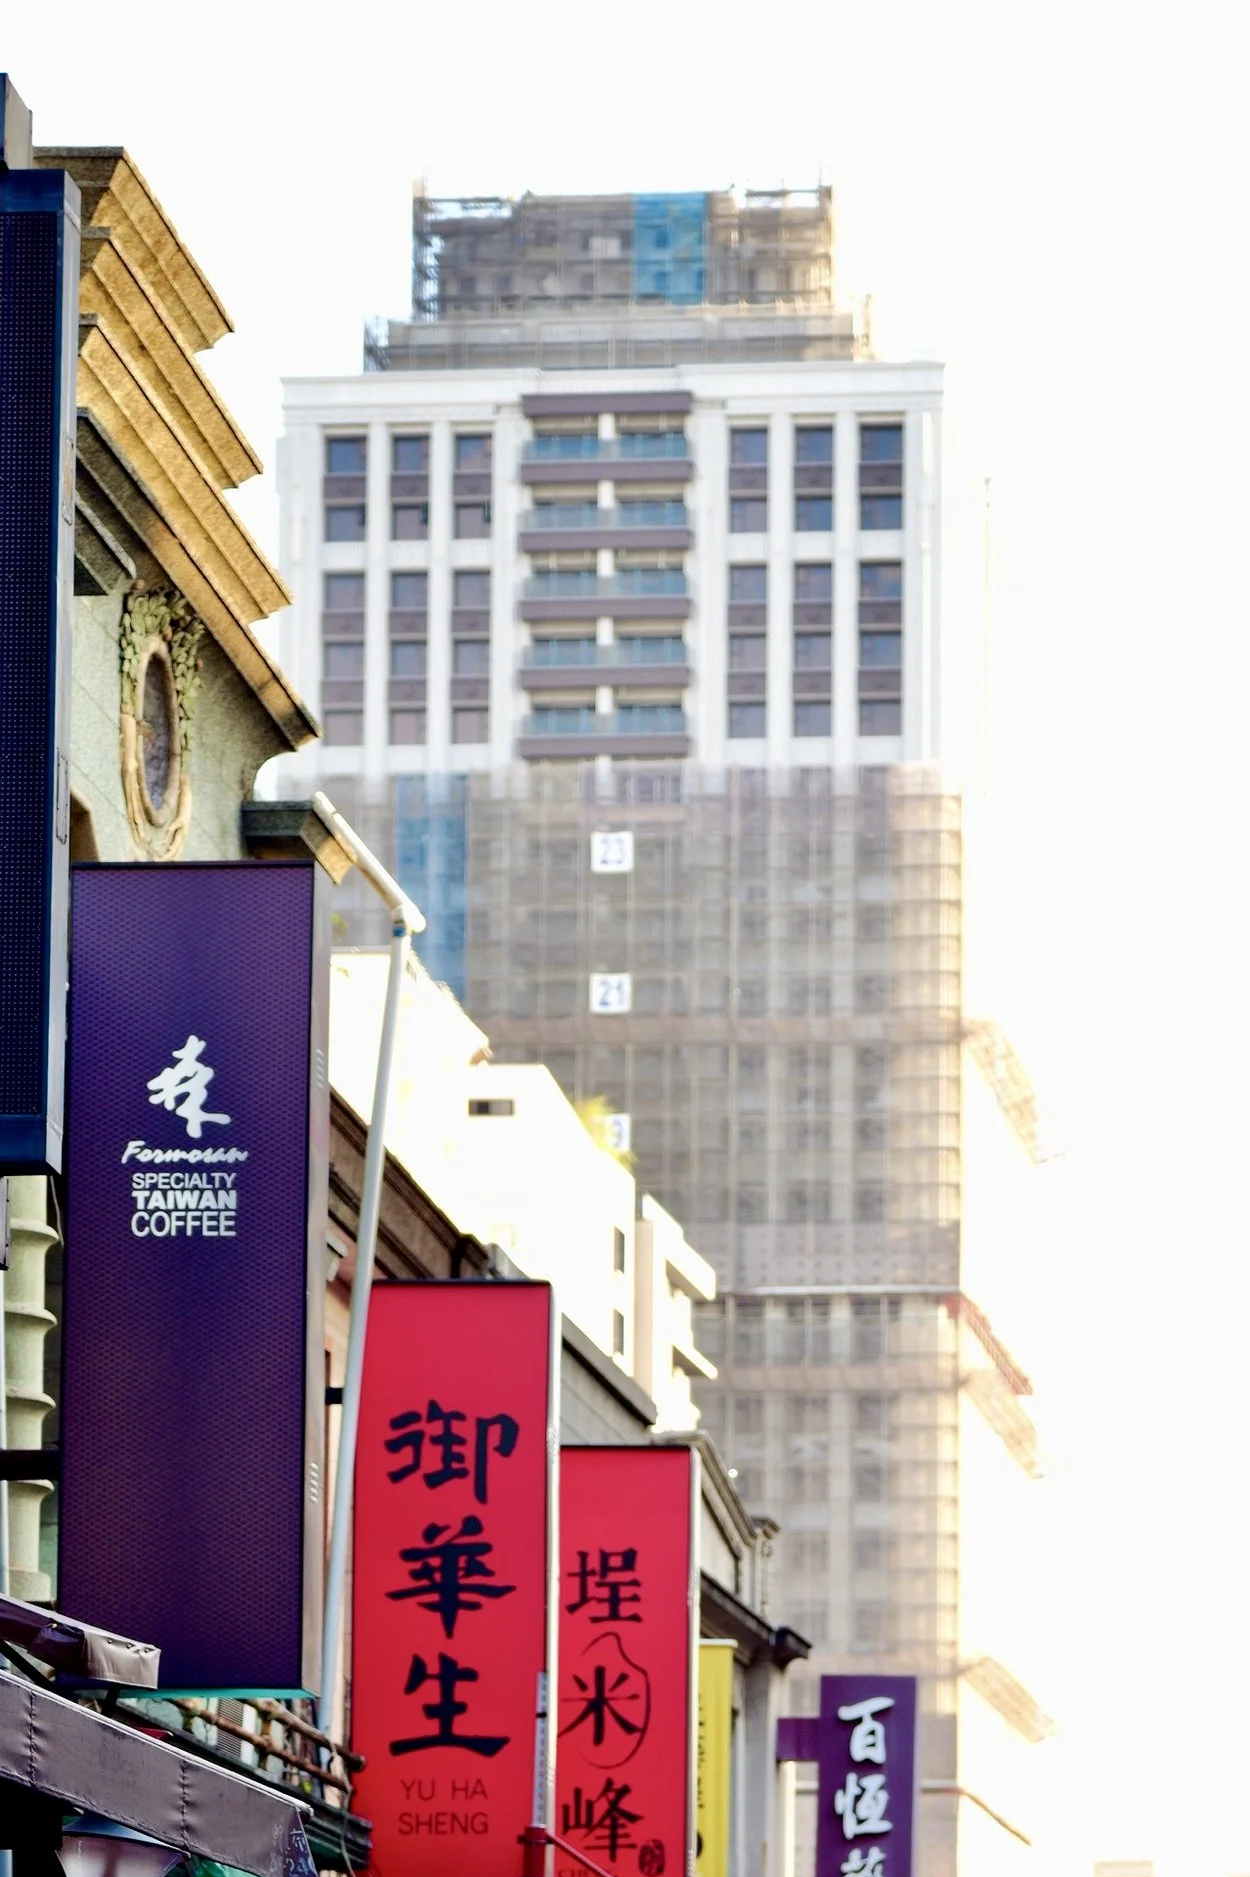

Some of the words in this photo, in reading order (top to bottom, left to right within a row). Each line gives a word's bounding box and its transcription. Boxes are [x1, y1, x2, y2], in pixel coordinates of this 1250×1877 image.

[121, 1140, 249, 1164] Formosan
[132, 1172, 237, 1189] SPECIALTY
[131, 1189, 237, 1210] TAIWAN
[131, 1211, 237, 1238] COFFEE
[384, 1399, 520, 1758] 御華生
[557, 1547, 643, 1863] 埕米峰
[400, 1779, 436, 1800] YU
[451, 1779, 489, 1800] HA
[398, 1812, 489, 1836] SHENG
